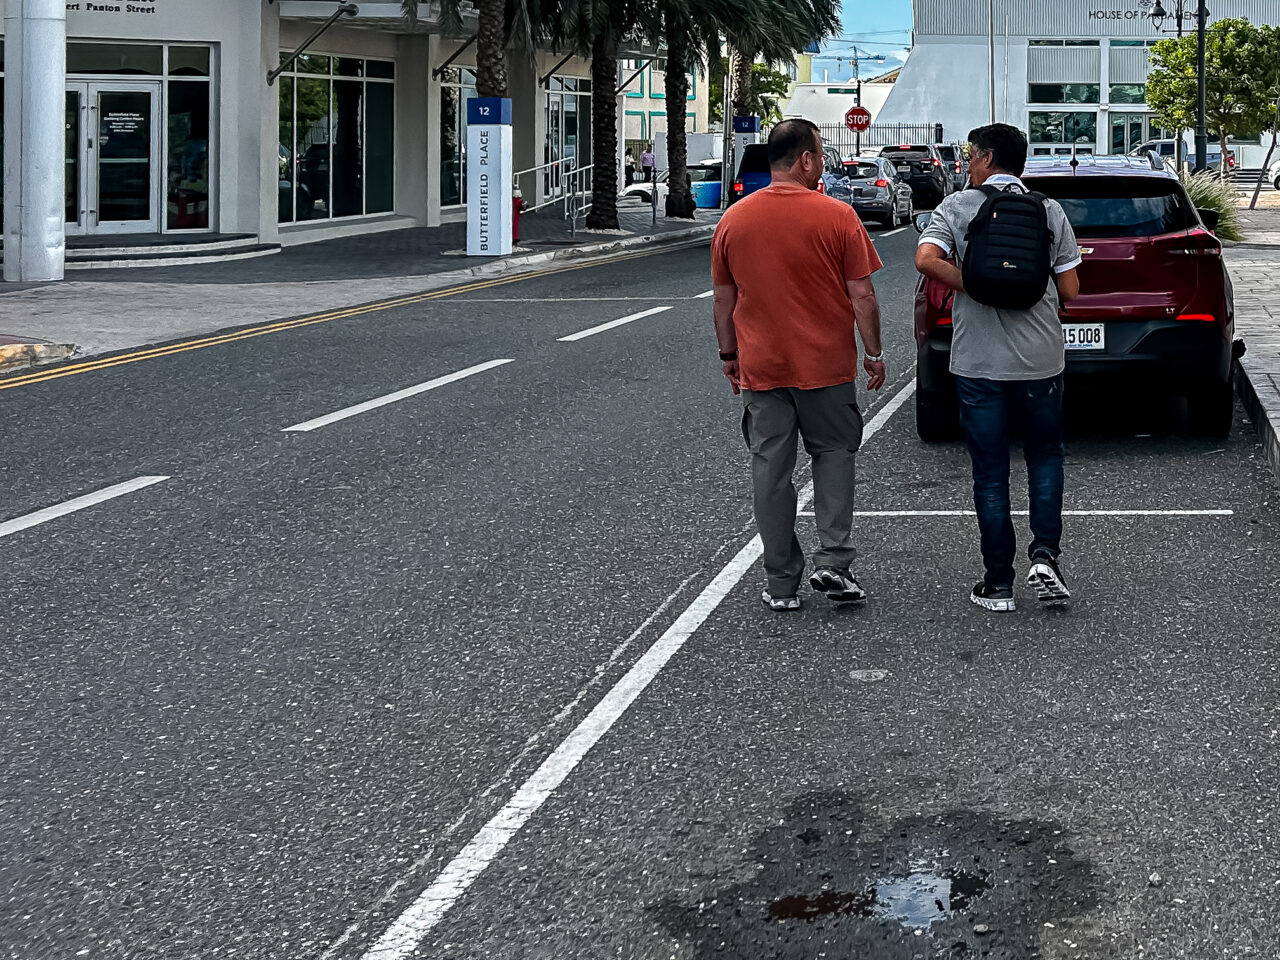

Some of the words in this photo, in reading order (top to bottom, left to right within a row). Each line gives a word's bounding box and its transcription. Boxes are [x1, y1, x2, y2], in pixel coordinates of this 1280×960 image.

[86, 3, 120, 12] Panton
[126, 4, 155, 14] Street
[1088, 11, 1122, 20] HOUSE
[1124, 11, 1138, 20] OF
[478, 106, 490, 116] 12
[847, 114, 869, 125] STOP
[480, 130, 489, 166] PLACE
[480, 173, 489, 251] BUTTERFIELD
[1078, 327, 1101, 344] 008
